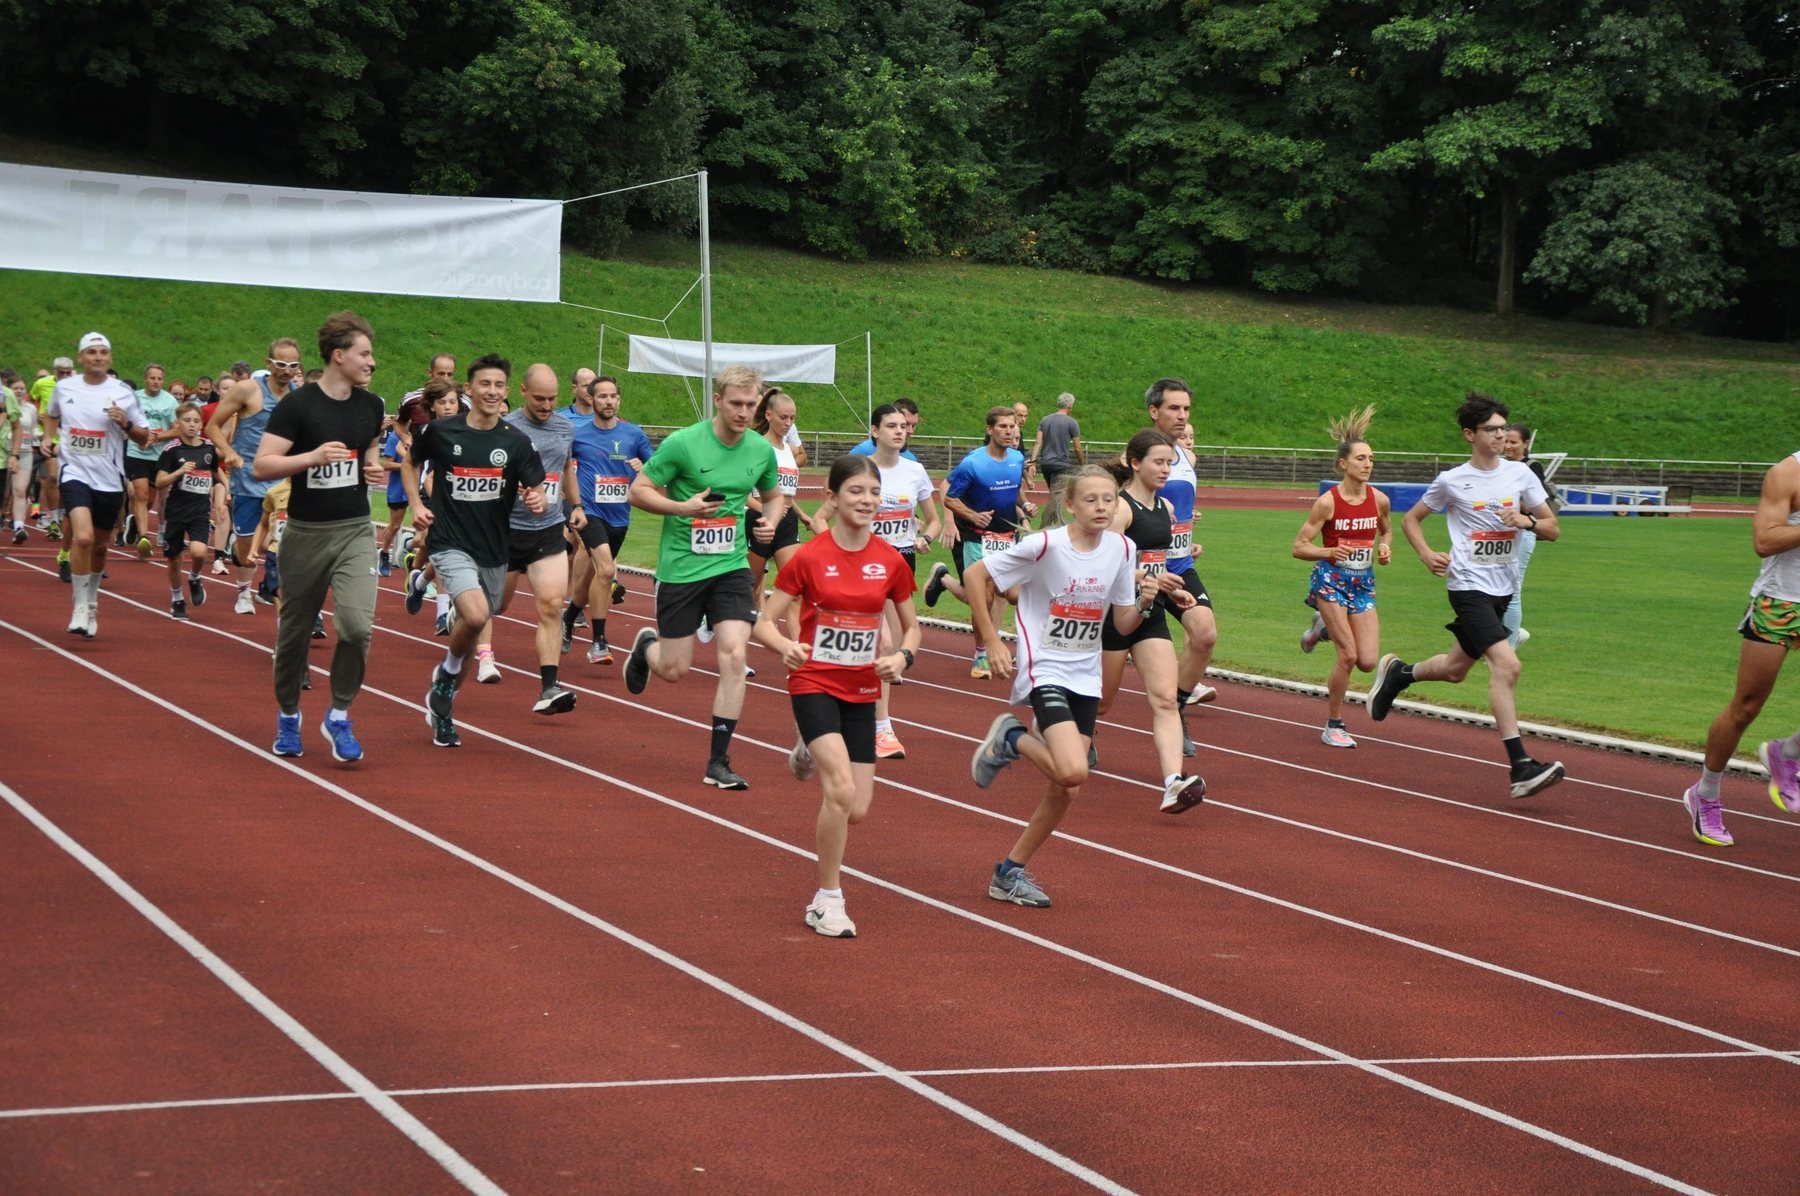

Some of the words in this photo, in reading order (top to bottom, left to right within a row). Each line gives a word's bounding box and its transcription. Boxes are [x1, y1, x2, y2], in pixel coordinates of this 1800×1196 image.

[71, 435, 102, 449] 2091
[311, 460, 354, 479] 2017
[185, 475, 210, 488] 2060
[456, 477, 498, 492] 2026
[777, 474, 798, 488] 2082
[543, 482, 556, 496] 71
[598, 484, 627, 496] 2063
[872, 519, 909, 535] 2079
[1335, 518, 1350, 531] NC
[1352, 516, 1378, 531] STATE
[695, 527, 733, 544] 2010
[1349, 549, 1370, 561] 051
[1474, 540, 1512, 556] 2080
[1143, 563, 1165, 575] 207
[1049, 618, 1100, 641] 2075
[819, 628, 875, 652] 2052
